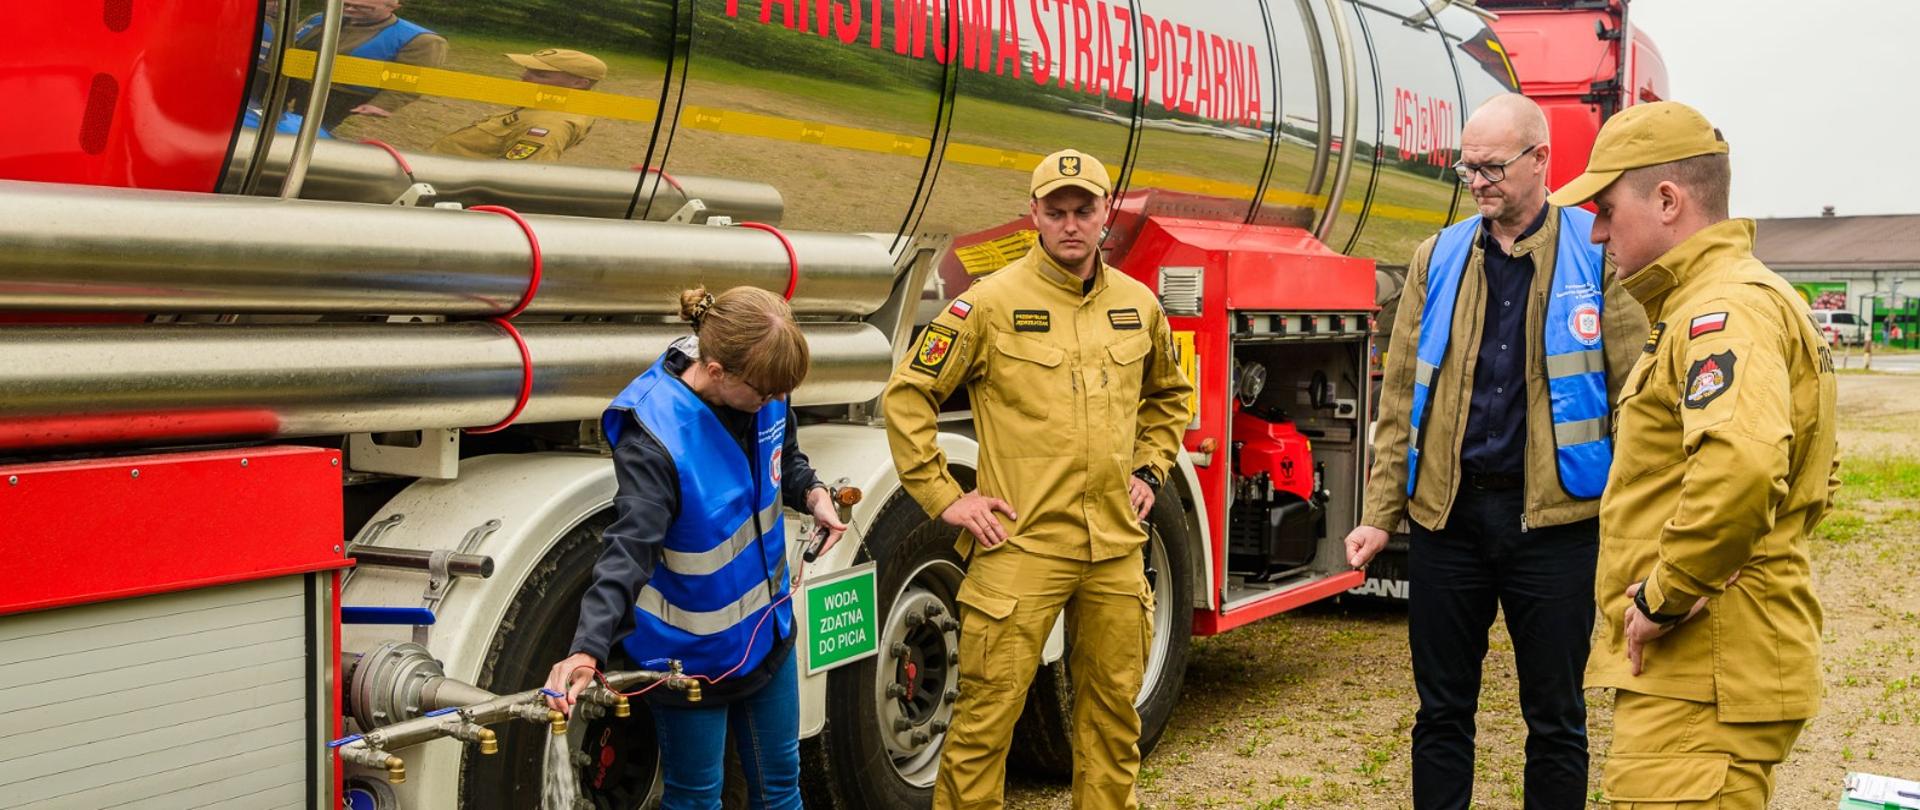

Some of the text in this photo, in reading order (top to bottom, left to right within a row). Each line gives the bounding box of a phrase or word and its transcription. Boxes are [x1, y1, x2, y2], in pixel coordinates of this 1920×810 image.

[1141, 14, 1261, 128] POŻARNA
[824, 589, 859, 611] WODA
[820, 608, 864, 634] ZDATNA
[819, 628, 866, 655] DO PICIA
